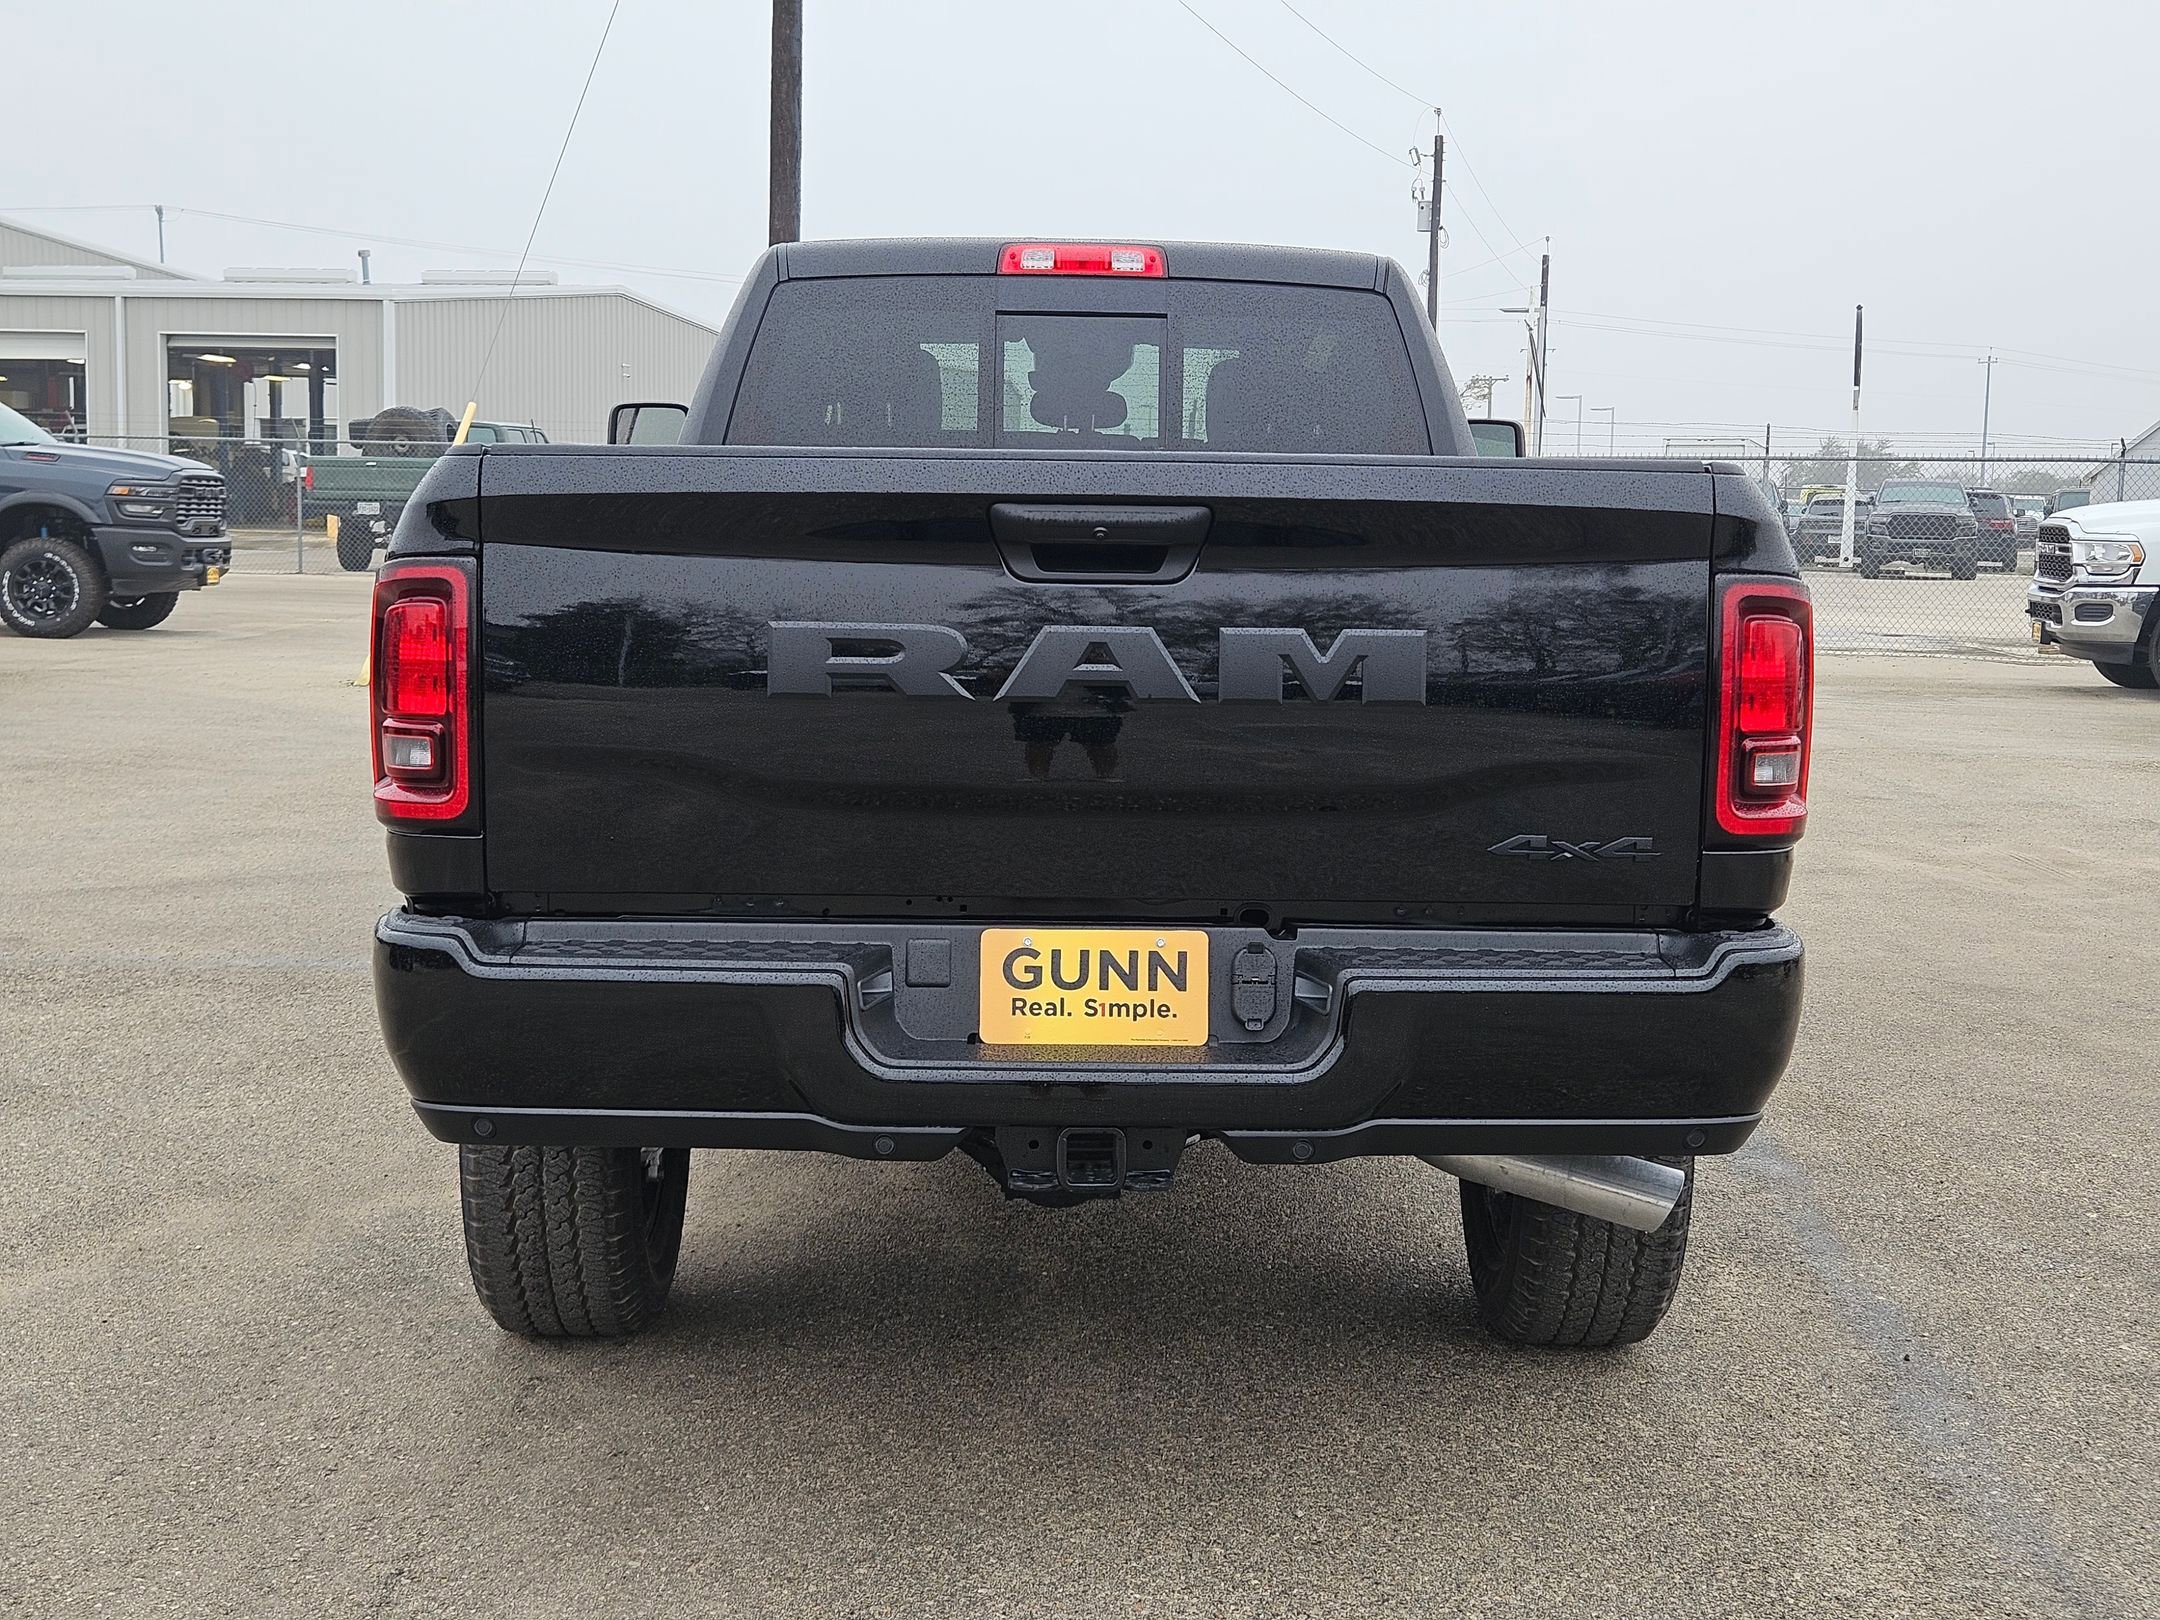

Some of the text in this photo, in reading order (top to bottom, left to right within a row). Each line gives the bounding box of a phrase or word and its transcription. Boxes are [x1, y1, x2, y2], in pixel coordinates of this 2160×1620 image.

[767, 621, 1428, 704] RAM
[1487, 834, 1662, 862] 4x4
[1003, 947, 1187, 992] GUNN
[1011, 997, 1072, 1017] Real.
